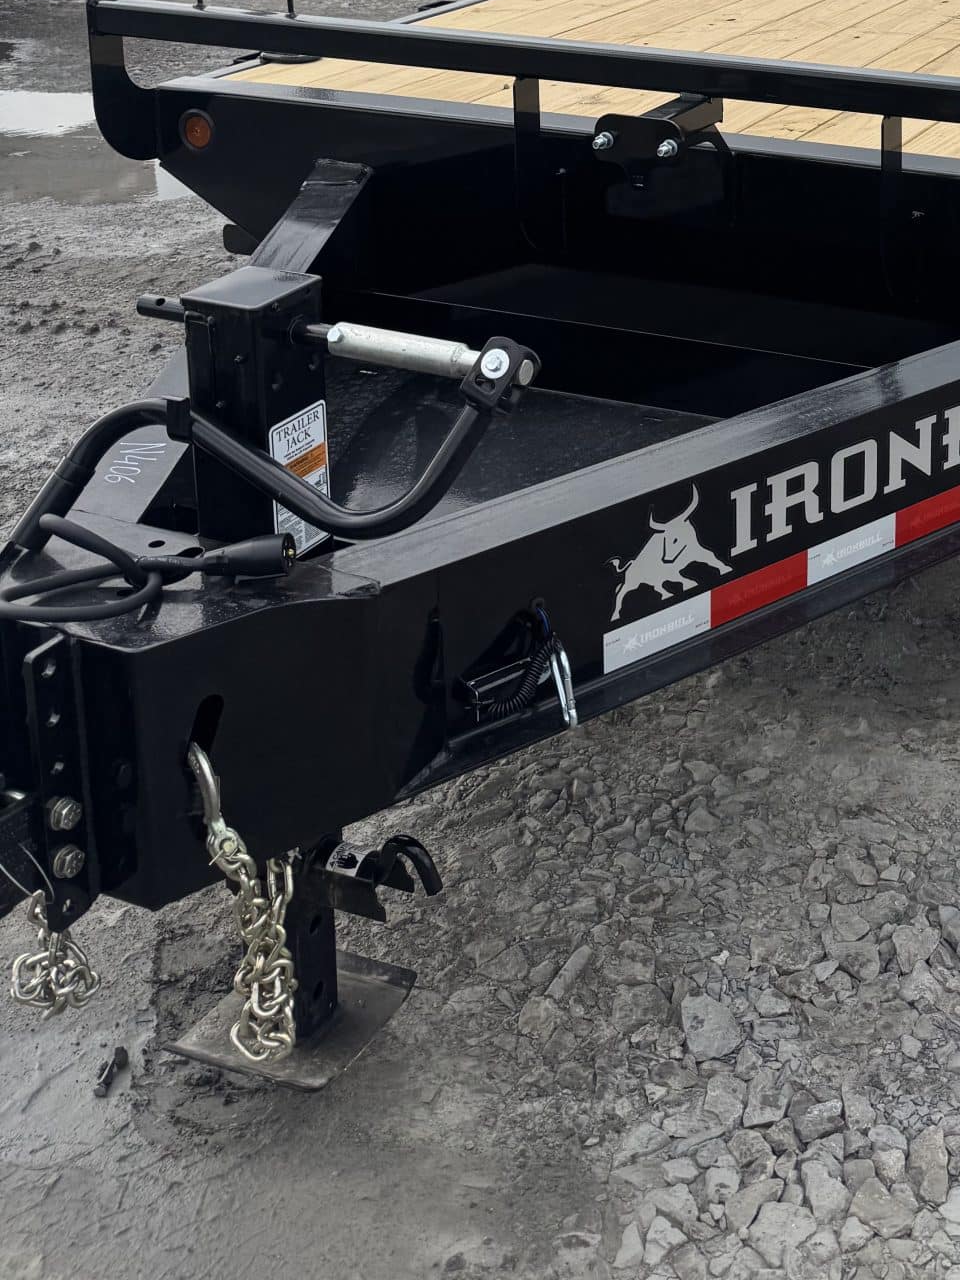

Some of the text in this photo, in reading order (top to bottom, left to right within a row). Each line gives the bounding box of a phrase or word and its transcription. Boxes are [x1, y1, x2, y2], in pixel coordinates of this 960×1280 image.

[276, 409, 320, 442] TRAILER
[286, 426, 312, 452] JACK
[640, 615, 695, 644] IRONBULL
